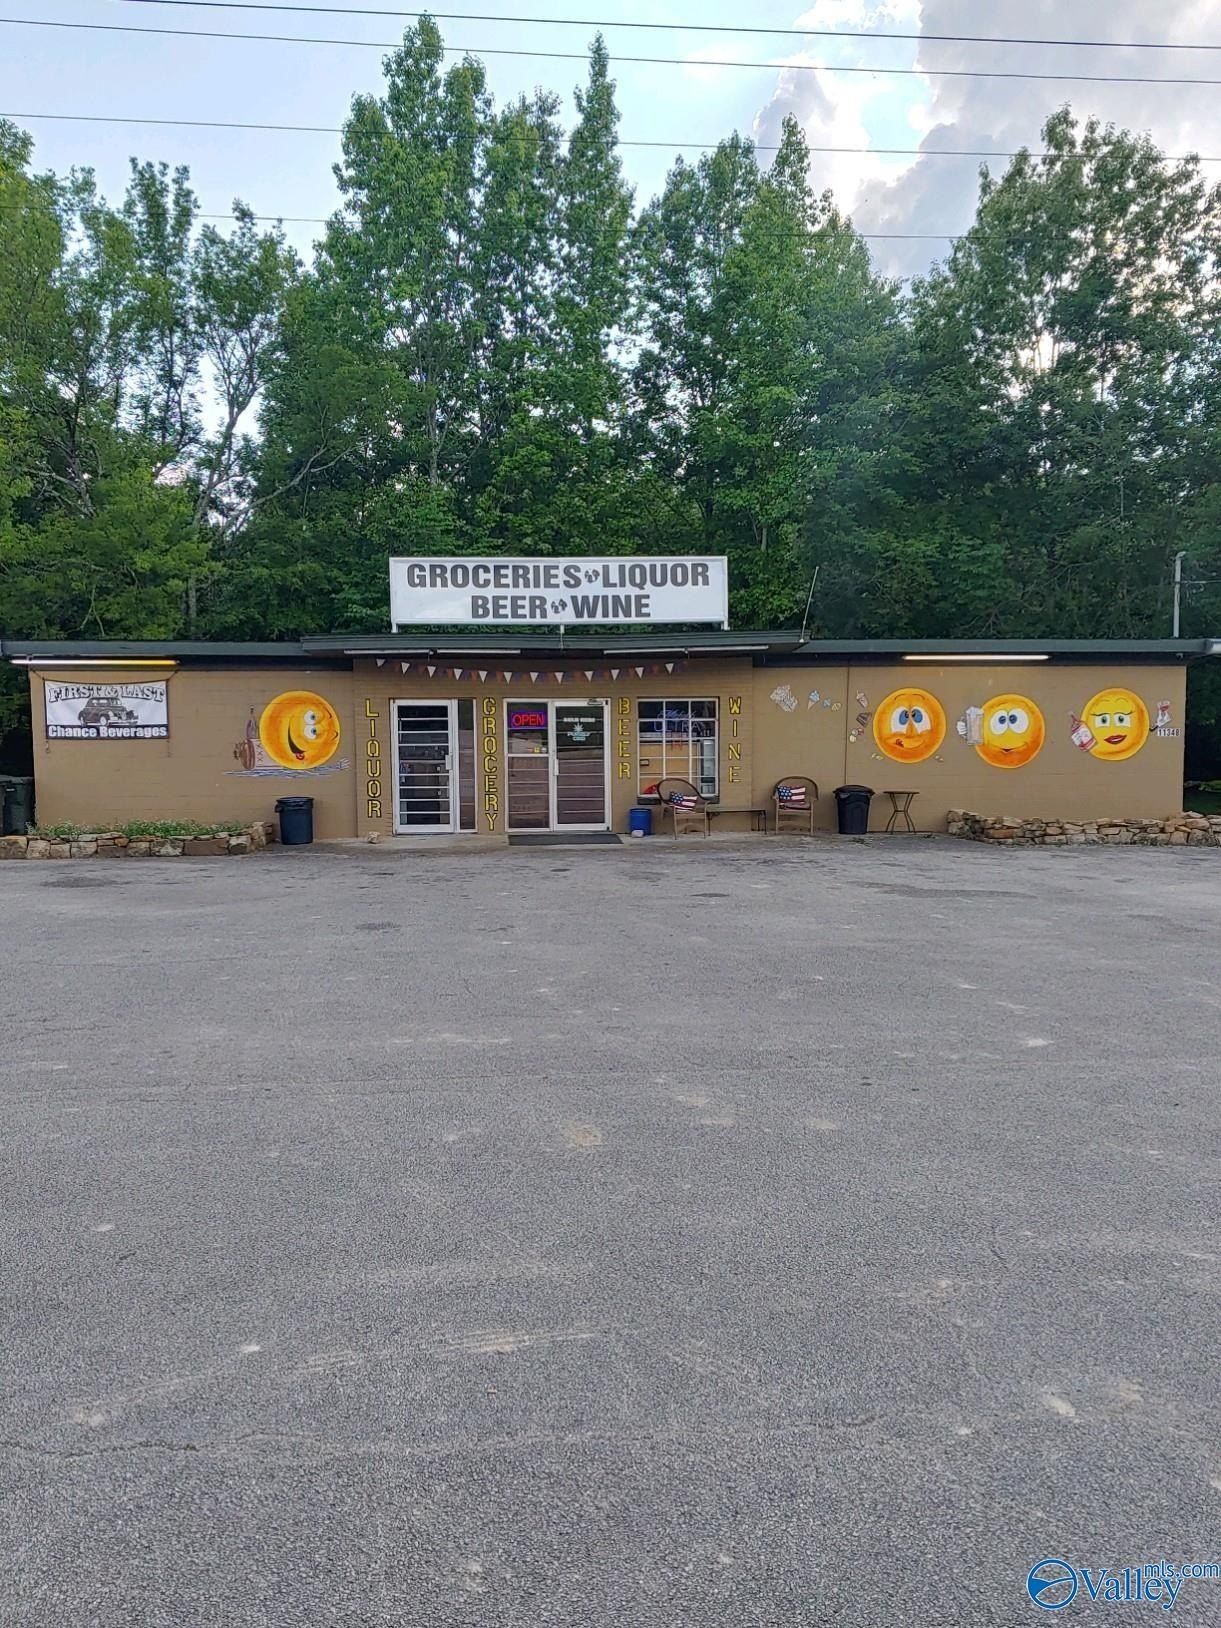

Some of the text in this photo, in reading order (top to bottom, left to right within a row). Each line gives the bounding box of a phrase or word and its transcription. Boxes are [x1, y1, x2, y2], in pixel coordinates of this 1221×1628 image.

[407, 562, 710, 590] GROCERIES LIQUOR
[471, 594, 651, 619] BEER WINE
[48, 685, 165, 703] FIRST & LAST
[48, 725, 168, 738] Chance Beverages
[512, 713, 545, 726] OPEN
[617, 697, 631, 779] BEER
[728, 696, 742, 783] WINE
[365, 698, 382, 818] LIQUOR
[482, 697, 499, 831] GROCERY
